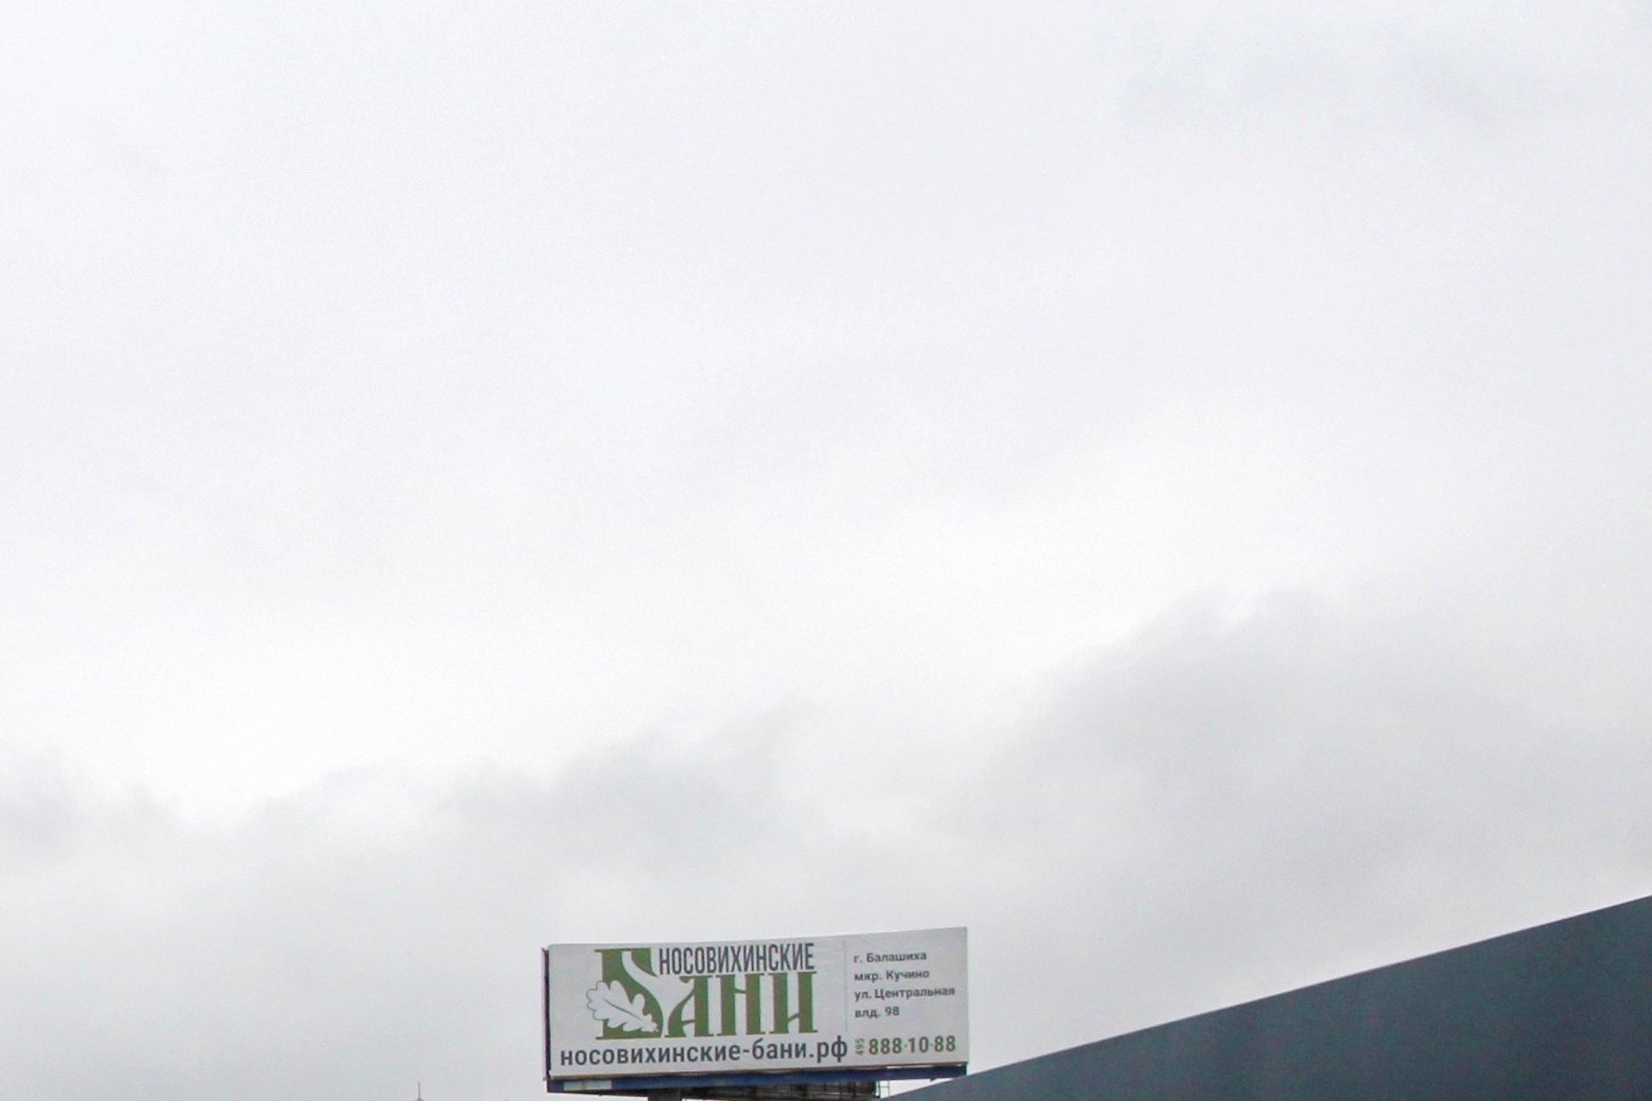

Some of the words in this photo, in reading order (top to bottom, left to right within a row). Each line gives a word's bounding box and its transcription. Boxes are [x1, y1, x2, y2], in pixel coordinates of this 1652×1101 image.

[659, 943, 815, 975] НОСОВИХИНСКИЕ
[853, 955, 863, 963] г.
[866, 952, 927, 963] Балашиха
[854, 972, 882, 982] мкр.
[886, 970, 930, 982] Кучино
[854, 991, 872, 1002] ул.
[874, 987, 956, 1000] Центральная
[855, 1009, 881, 1019] влд.
[885, 1006, 900, 1016] 98
[560, 1035, 848, 1067] носовихинские-бани.рф
